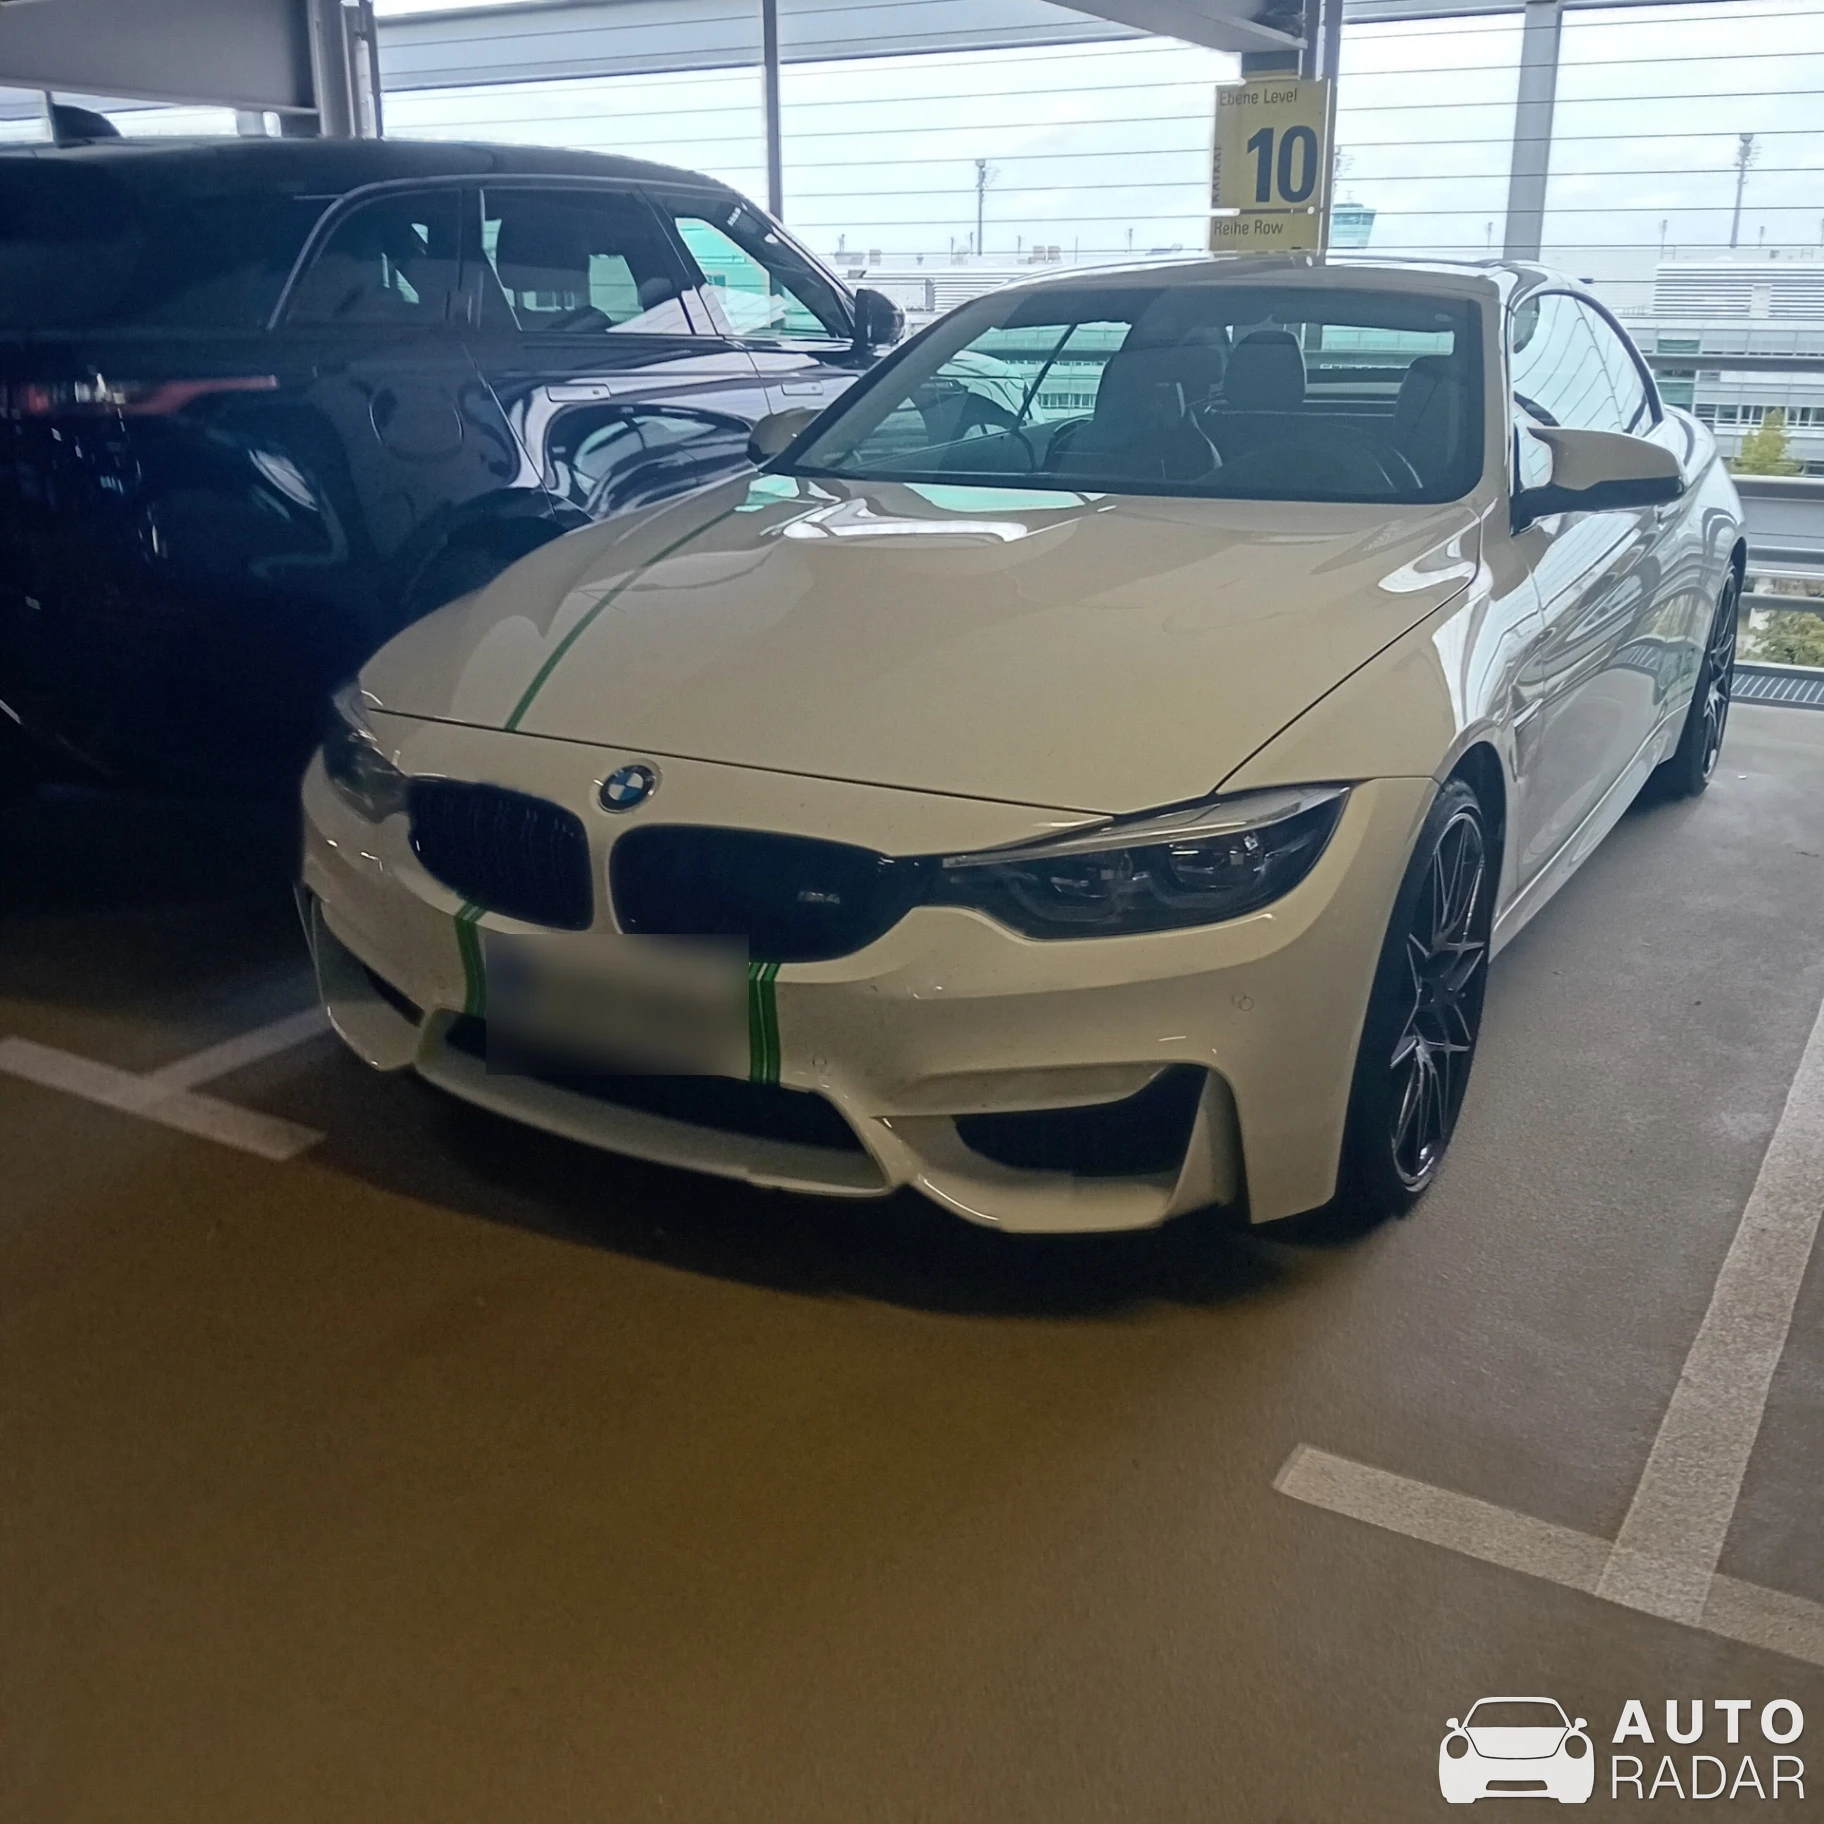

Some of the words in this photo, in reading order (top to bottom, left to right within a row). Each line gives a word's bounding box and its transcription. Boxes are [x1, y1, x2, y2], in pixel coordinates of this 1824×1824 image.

[1219, 89, 1259, 106] Ebene
[1263, 87, 1298, 104] Level
[1247, 125, 1318, 203] 10
[1214, 220, 1249, 236] Reihe
[1254, 219, 1284, 235] Row
